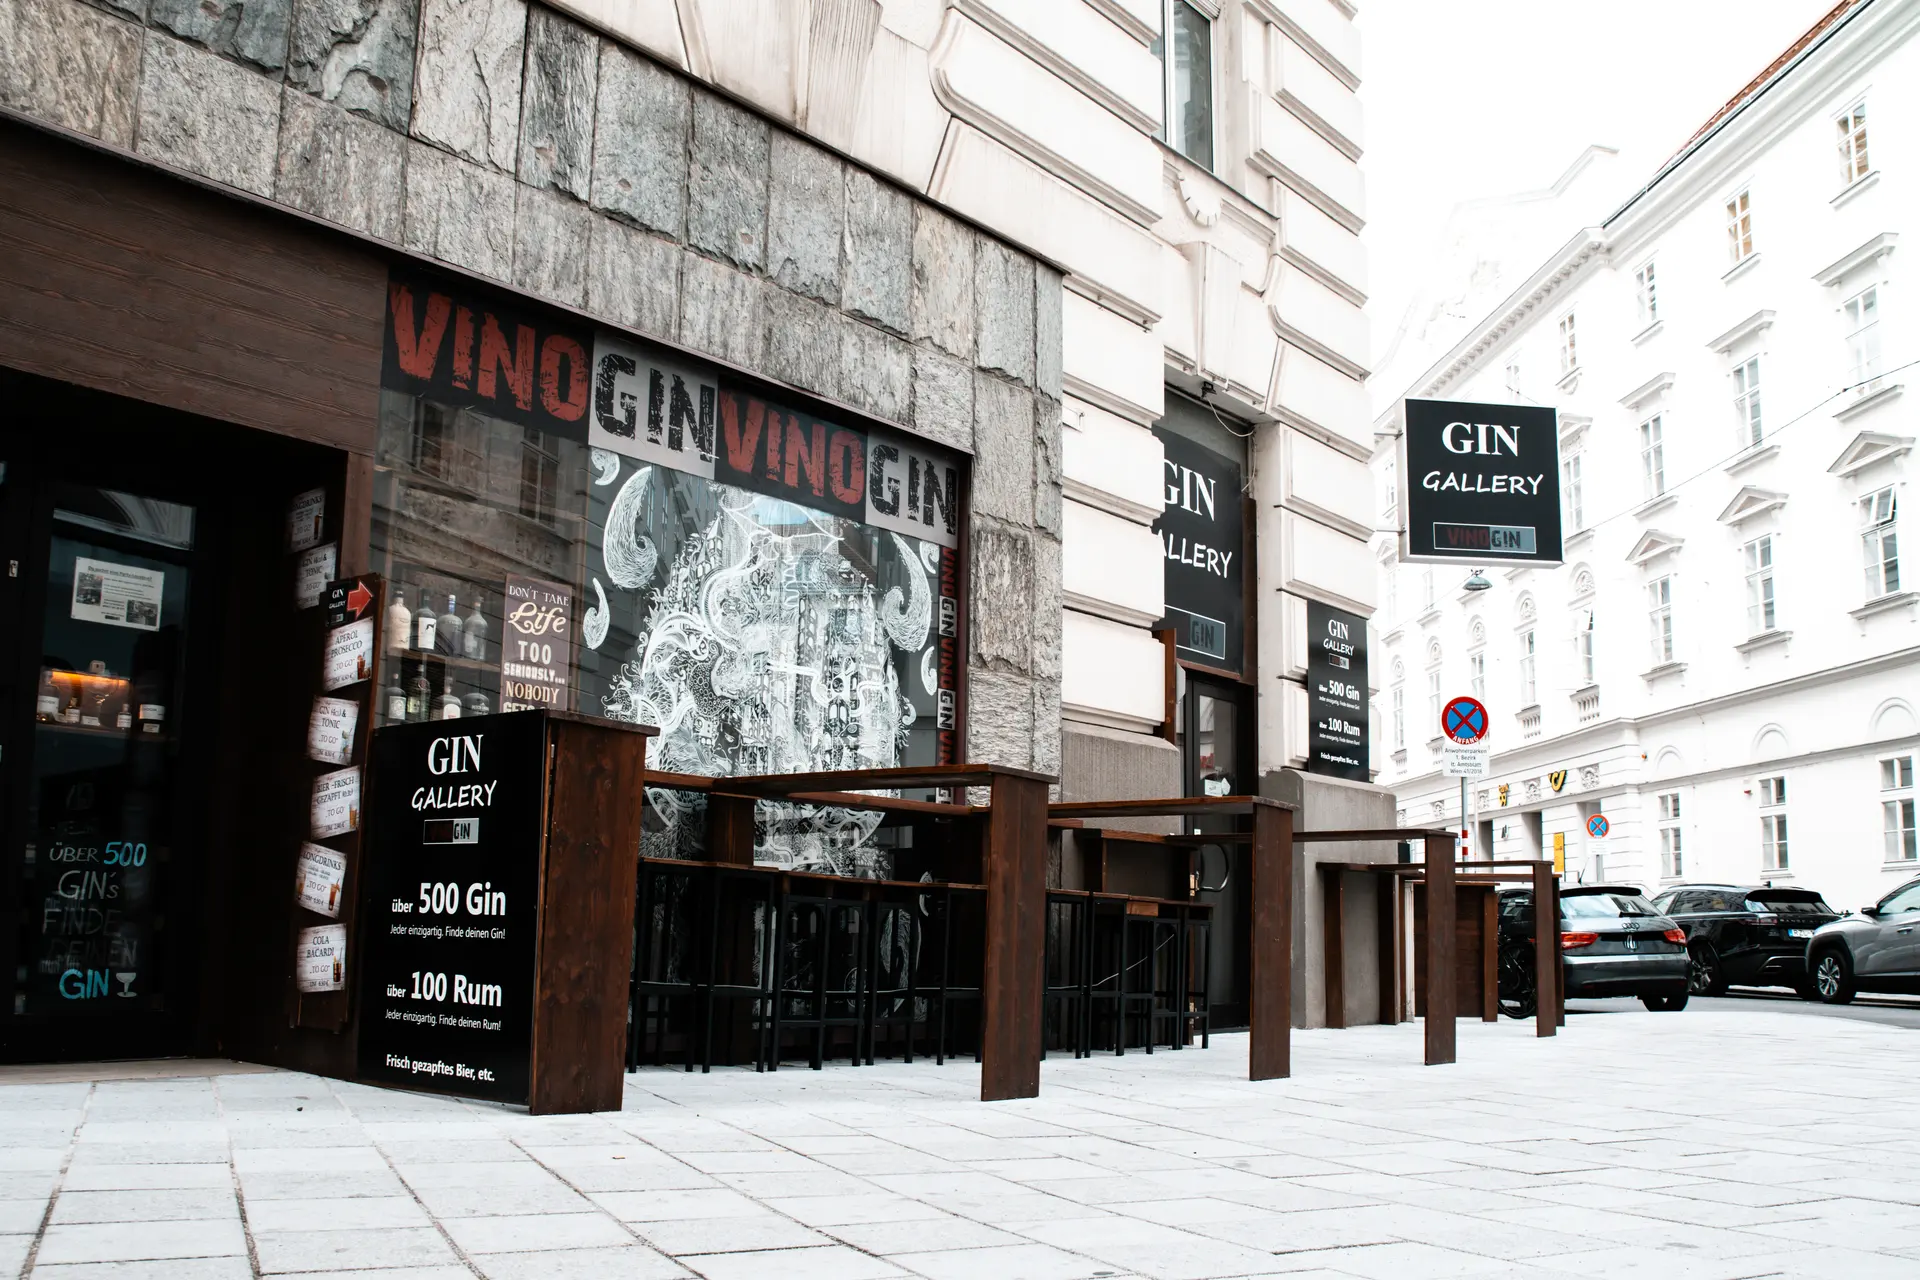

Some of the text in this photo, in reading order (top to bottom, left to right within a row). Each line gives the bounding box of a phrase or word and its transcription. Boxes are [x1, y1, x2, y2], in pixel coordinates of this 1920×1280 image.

[389, 282, 957, 536] VINO GIN VINO GIN
[1442, 422, 1520, 457] GIN
[1164, 458, 1216, 521] GIN
[1422, 471, 1544, 495] GALLERY
[1446, 526, 1521, 549] VINO GIN
[1158, 528, 1232, 578] ALLERY
[332, 588, 344, 599] GIN
[509, 585, 569, 606] DON'T TAKE
[508, 602, 567, 635] Life
[941, 598, 954, 636] GIN
[1191, 620, 1214, 650] GIN
[1328, 619, 1348, 640] GIN
[330, 640, 363, 658] PROSECCO
[518, 640, 552, 665] TOO
[1323, 638, 1354, 656] GALLERY
[505, 680, 560, 704] NOBODY
[1329, 679, 1344, 697] 500
[1345, 684, 1360, 701] Gin
[940, 691, 953, 729] GIN
[321, 718, 340, 729] TONIC
[1328, 717, 1342, 733] 100
[1343, 720, 1360, 736] Rum
[1452, 735, 1479, 745] ANFANG
[428, 734, 484, 775] GIN
[316, 782, 330, 794] BIER
[316, 791, 342, 805] GEZAPFT
[411, 779, 498, 811] GALLERY
[454, 823, 470, 840] GIN
[49, 841, 147, 867] ÜBER 500
[303, 851, 341, 871] LONGDRINKS
[391, 881, 506, 916] über 500 Gin
[42, 907, 122, 937] FINDE
[390, 924, 506, 940] Jeder einzigartig. Finde deinen Gin!
[312, 935, 330, 946] COLA
[47, 938, 138, 968] DEINEN
[58, 967, 110, 1000] GIN
[387, 971, 502, 1007] über 100 Rum
[385, 1009, 501, 1031] Jeder einzigartig. Finde deinen Rum!
[386, 1054, 495, 1082] Frisch gezapftes Bier, etc.
